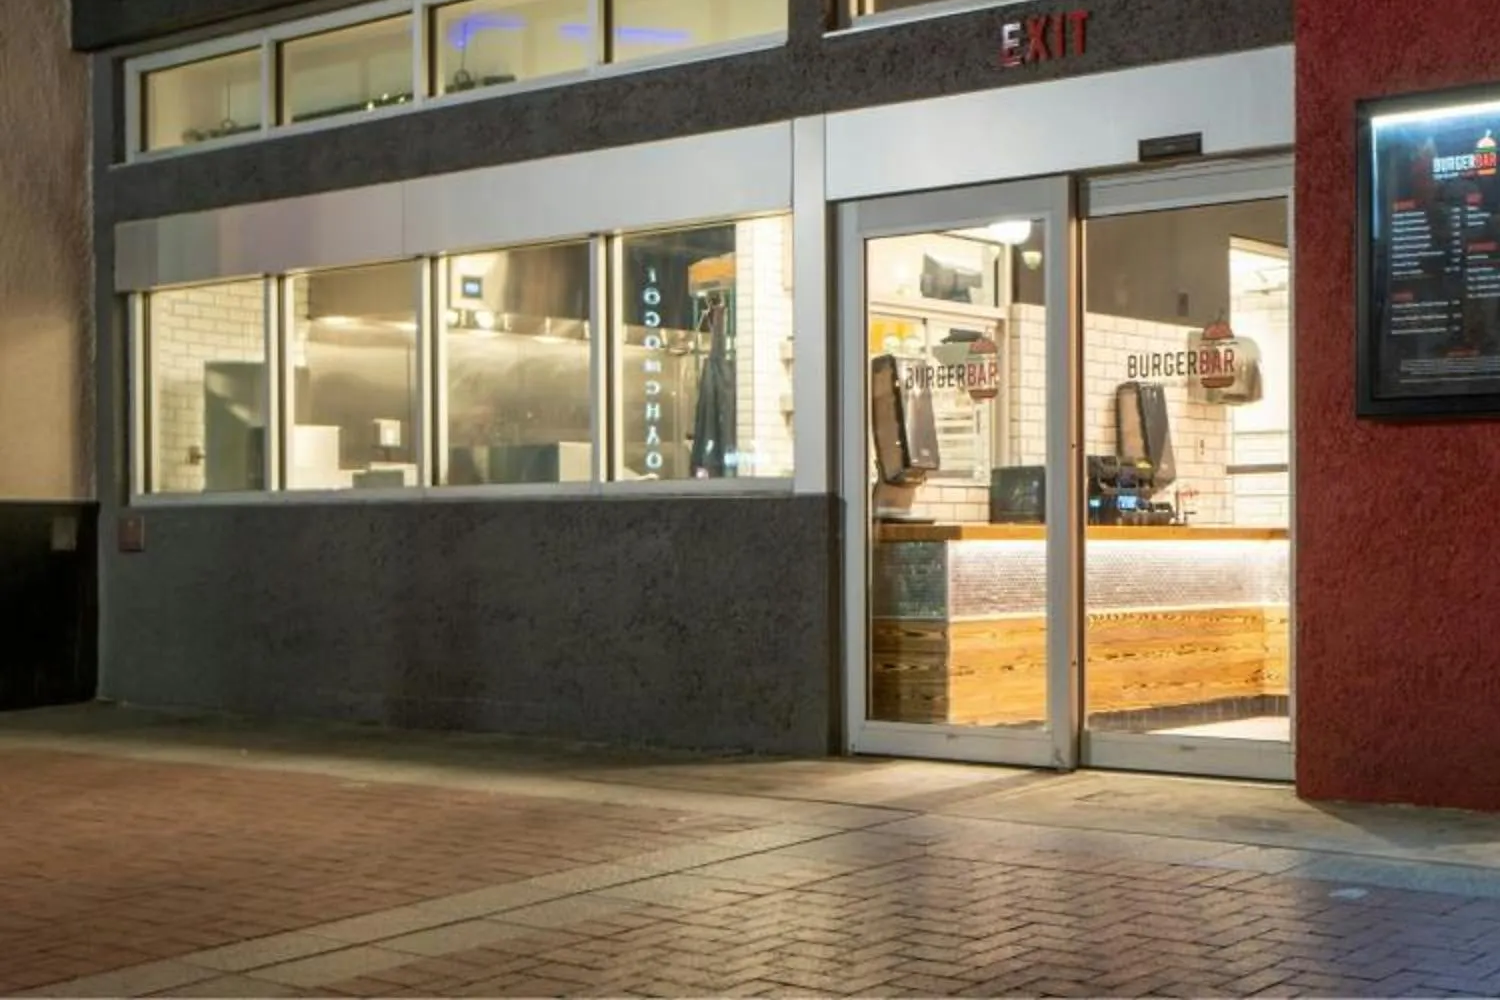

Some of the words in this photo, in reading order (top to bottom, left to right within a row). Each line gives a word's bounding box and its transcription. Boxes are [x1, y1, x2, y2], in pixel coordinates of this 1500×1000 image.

[1000, 8, 1089, 67] EXIT
[905, 362, 998, 391] BURGERBAR
[1127, 348, 1235, 379] BURGERBAR
